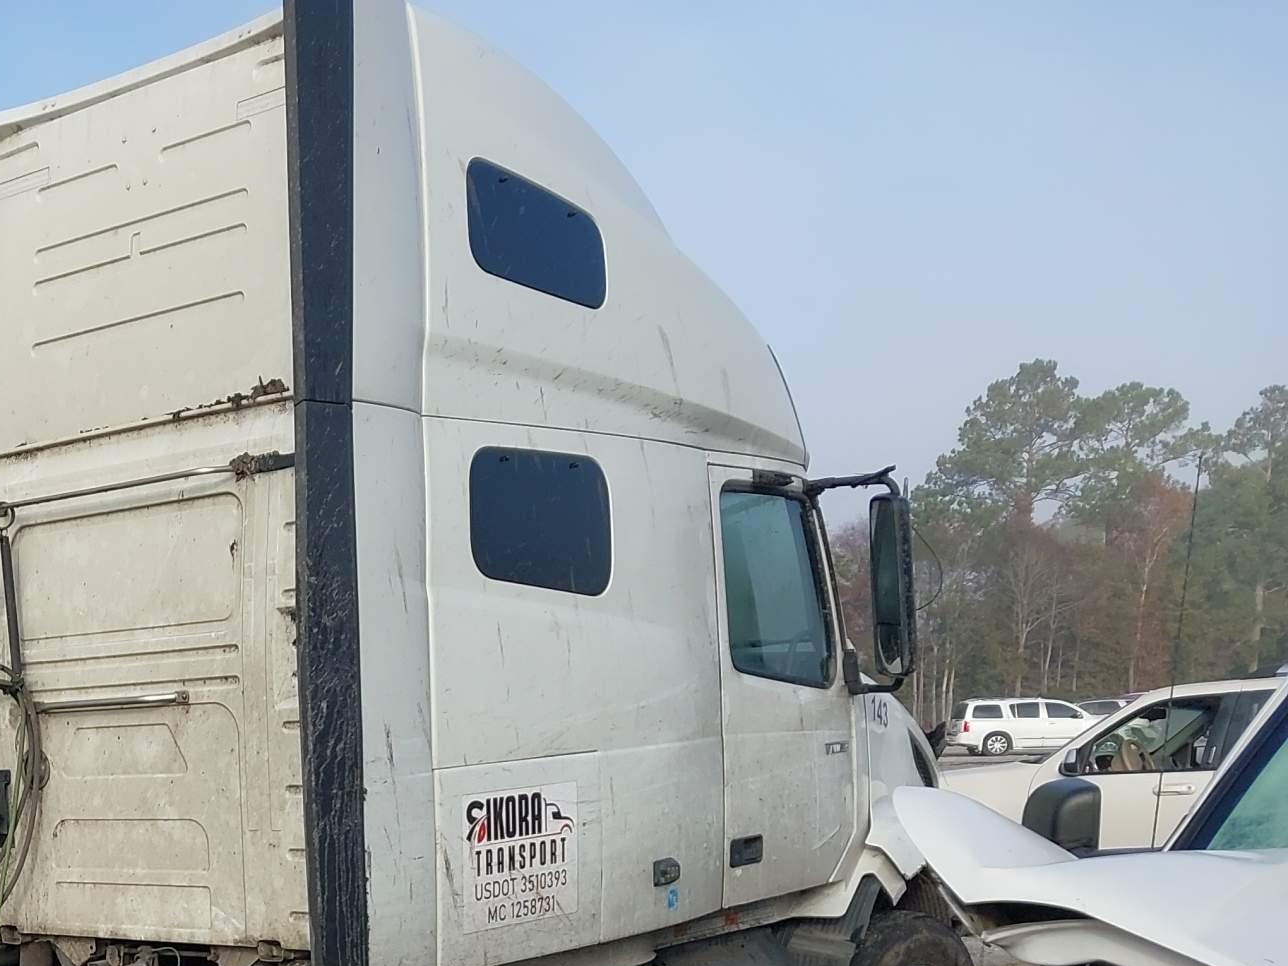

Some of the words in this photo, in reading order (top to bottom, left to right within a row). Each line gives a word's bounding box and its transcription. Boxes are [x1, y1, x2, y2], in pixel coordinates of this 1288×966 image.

[871, 696, 889, 728] 143
[466, 792, 542, 843] SIKORA
[475, 837, 566, 877] TRANSPORT
[475, 877, 518, 901] USDOT
[520, 869, 567, 893] 3510393
[487, 904, 507, 924] MC
[511, 895, 556, 919] 1258731
